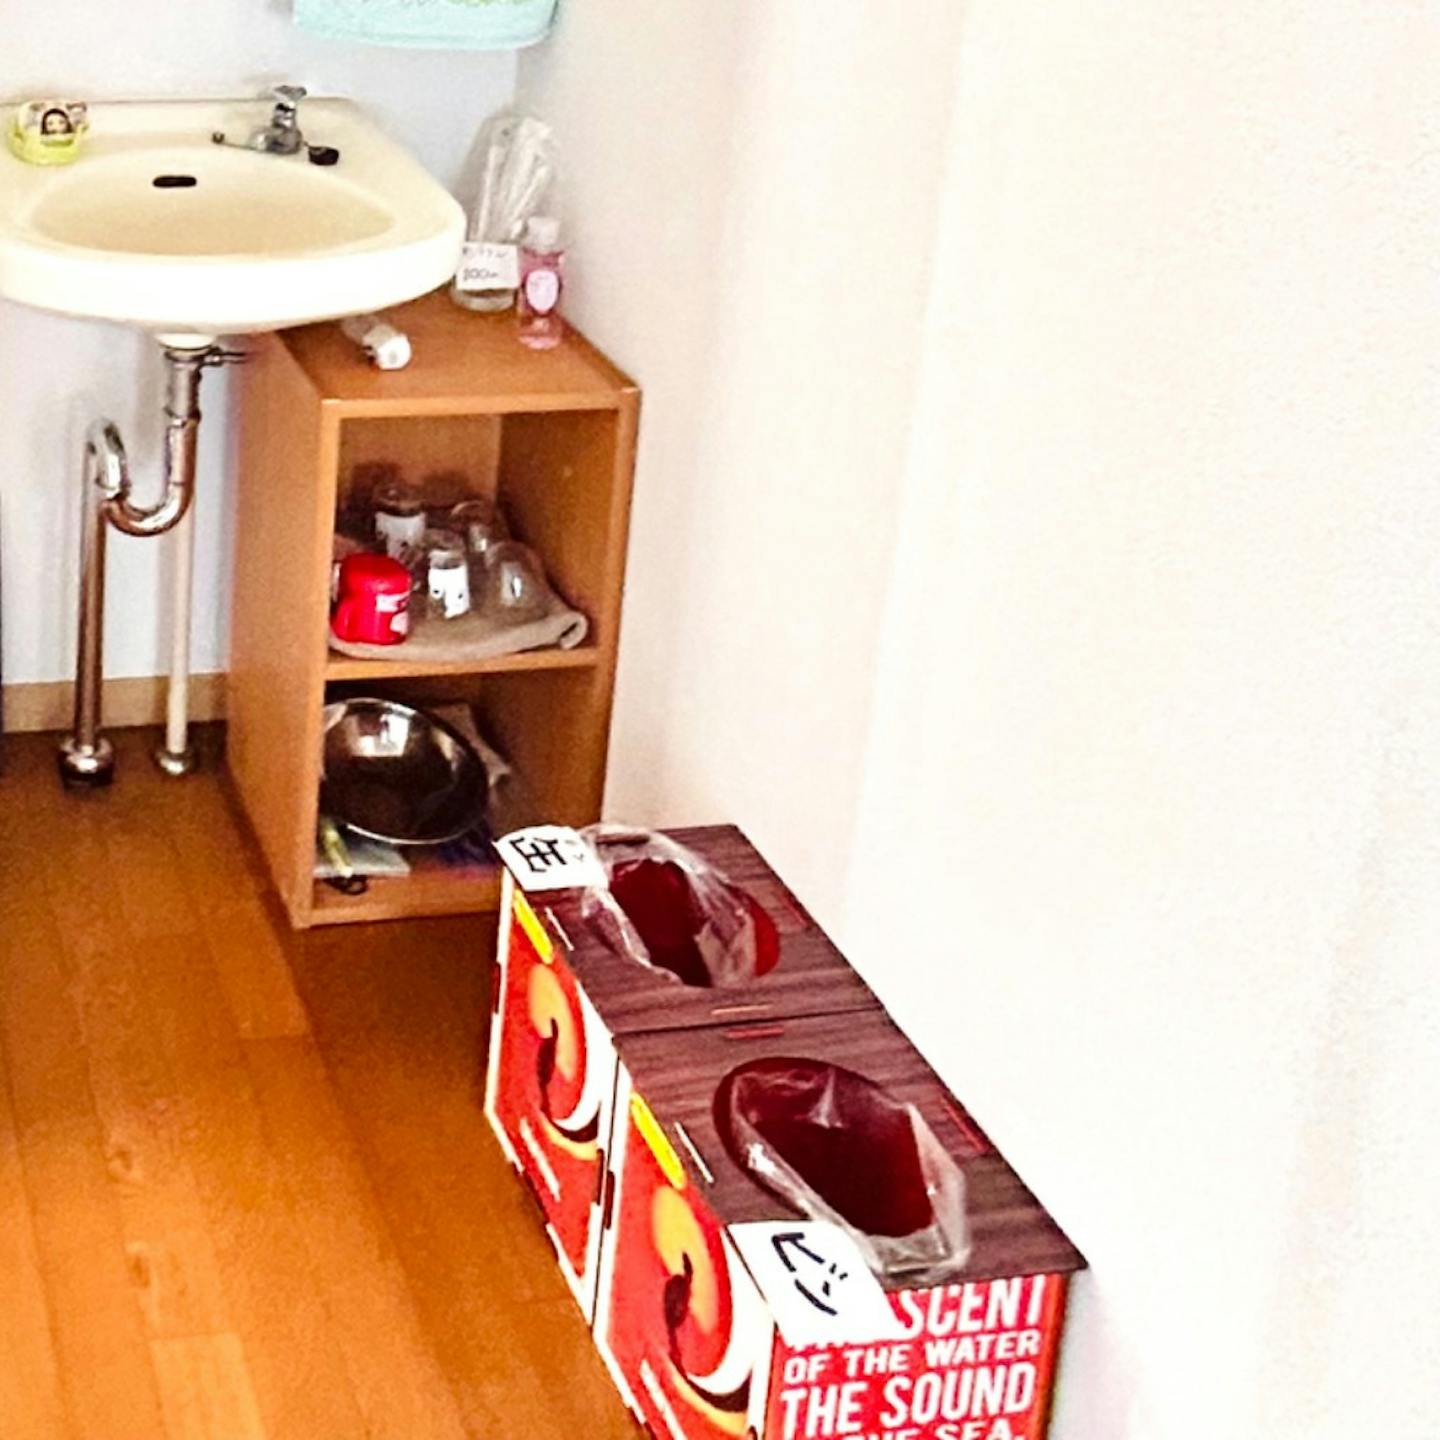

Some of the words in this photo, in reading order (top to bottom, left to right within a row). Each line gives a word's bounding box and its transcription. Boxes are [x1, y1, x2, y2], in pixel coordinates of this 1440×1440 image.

[783, 1353, 832, 1385] OF
[843, 1344, 910, 1377] THE
[925, 1328, 1041, 1368] WATER
[780, 1382, 868, 1440] THE
[879, 1361, 1037, 1428] SOUND
